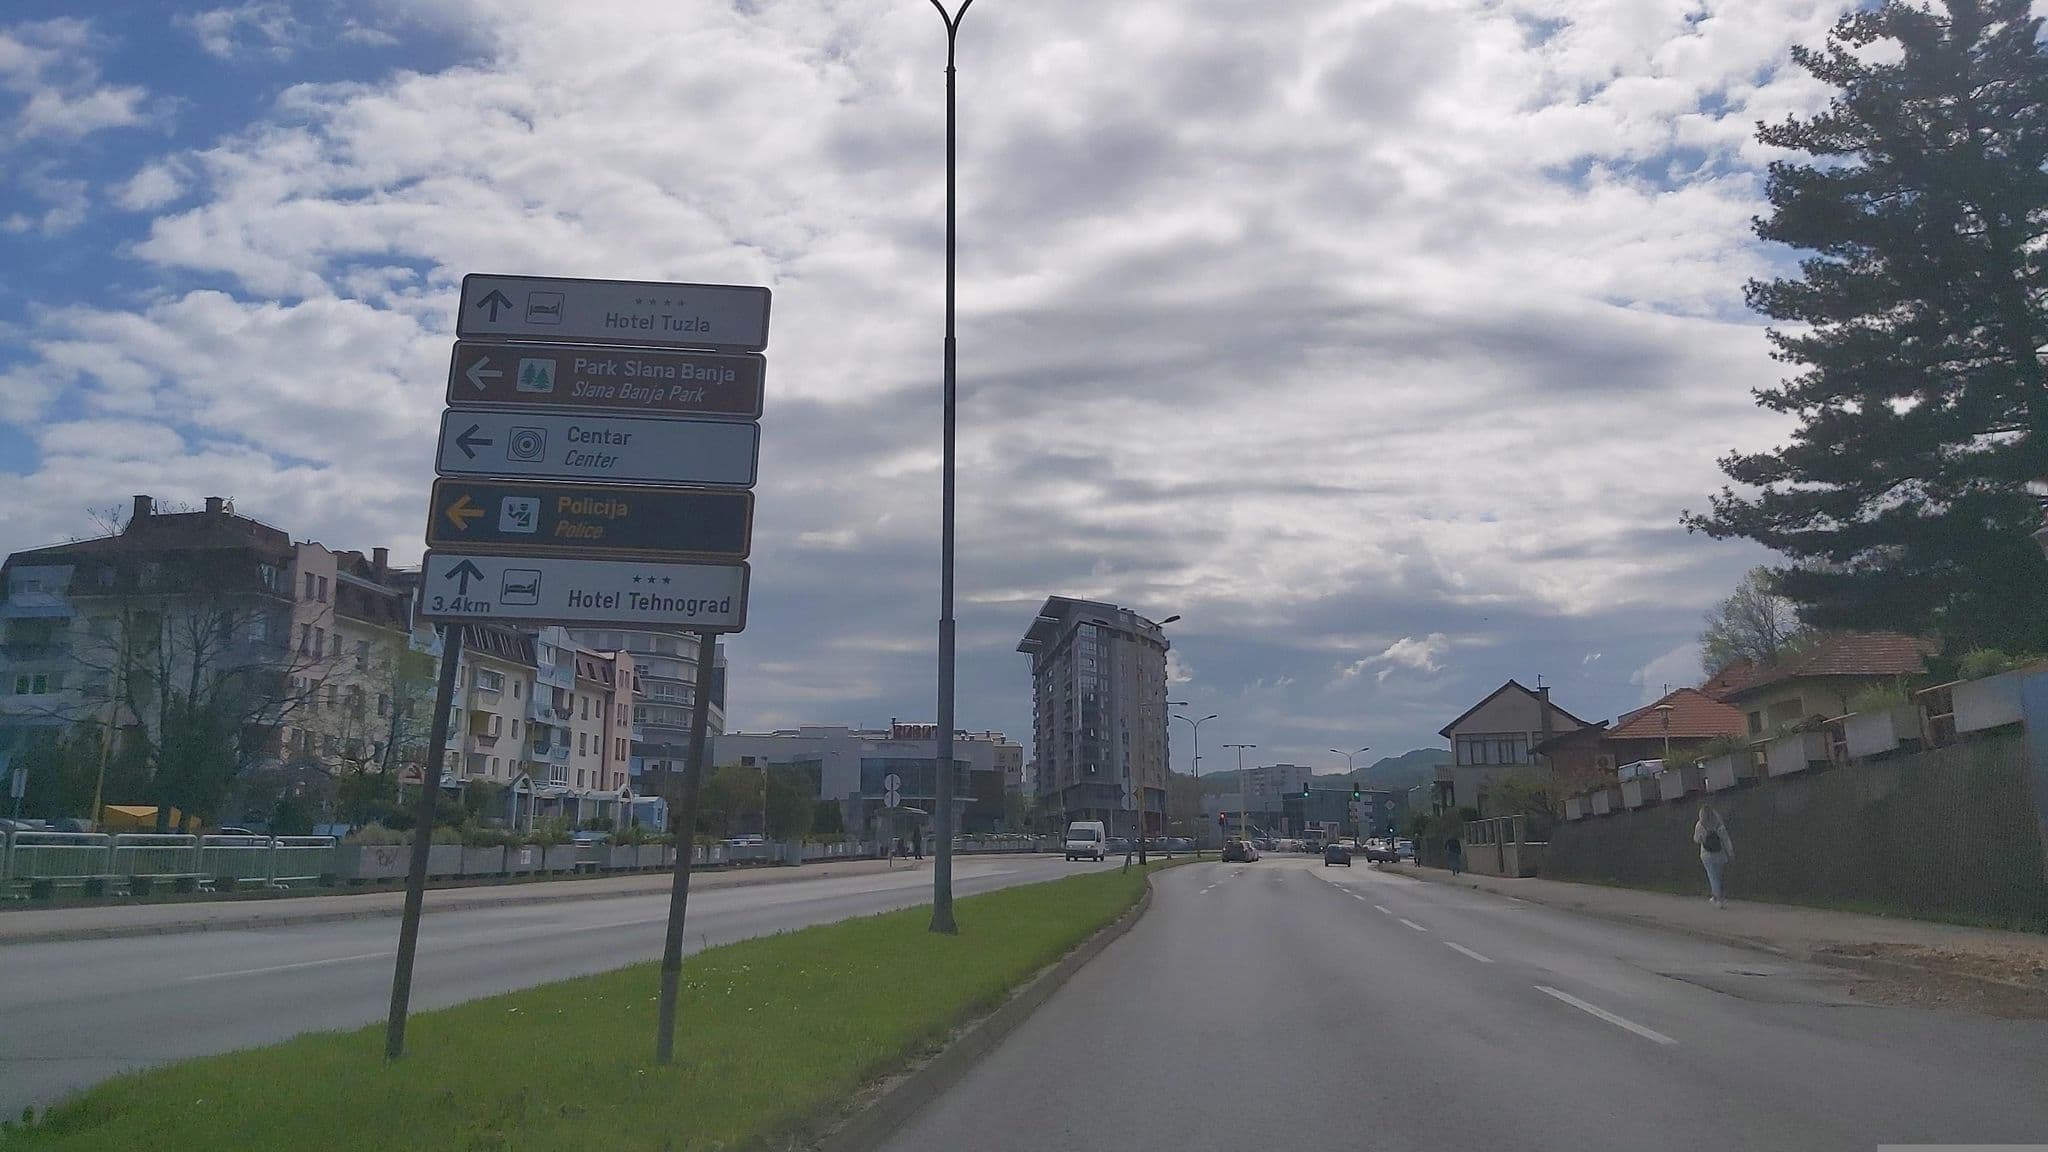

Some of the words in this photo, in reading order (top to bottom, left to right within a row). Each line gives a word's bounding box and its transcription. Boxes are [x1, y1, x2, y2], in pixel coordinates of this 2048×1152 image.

[605, 312, 655, 330] Hotel
[661, 315, 711, 333] Tuzla
[574, 358, 617, 376] Park
[624, 360, 675, 379] Slana
[681, 363, 736, 385] Banja
[572, 381, 614, 398] Slana
[618, 383, 664, 404] Banja
[669, 386, 705, 402] Park
[567, 426, 632, 446] Centar
[564, 450, 619, 469] Center
[557, 496, 629, 520] Policija
[554, 520, 604, 540] Police
[568, 590, 620, 609] Hotel
[629, 592, 731, 617] Tehnograd
